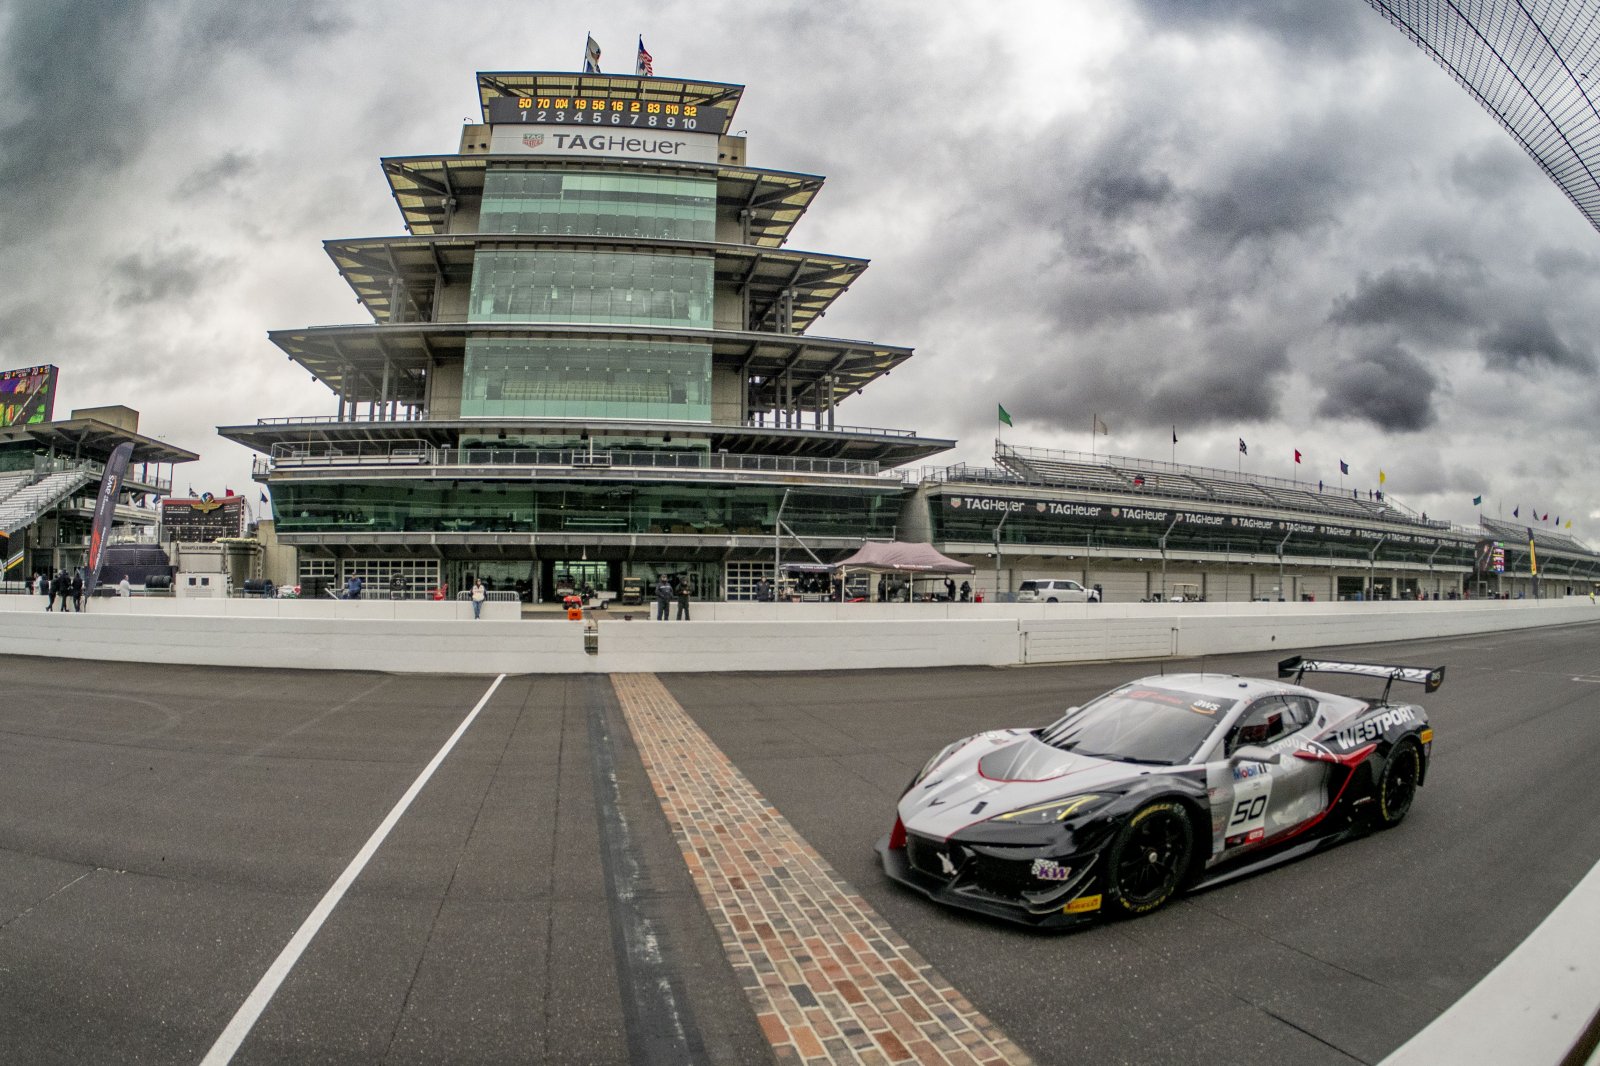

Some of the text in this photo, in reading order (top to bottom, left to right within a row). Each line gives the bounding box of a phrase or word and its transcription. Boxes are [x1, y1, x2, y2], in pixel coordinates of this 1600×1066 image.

[518, 98, 697, 117] 50 70 004 19 56 16 2 83 610 32
[520, 111, 697, 130] 1 2 3 4 5 6 7 8 9 10
[1193, 699, 1221, 711] aws
[1336, 705, 1416, 750] WESTPORT
[1231, 795, 1267, 827] 50
[1037, 865, 1072, 881] KW
